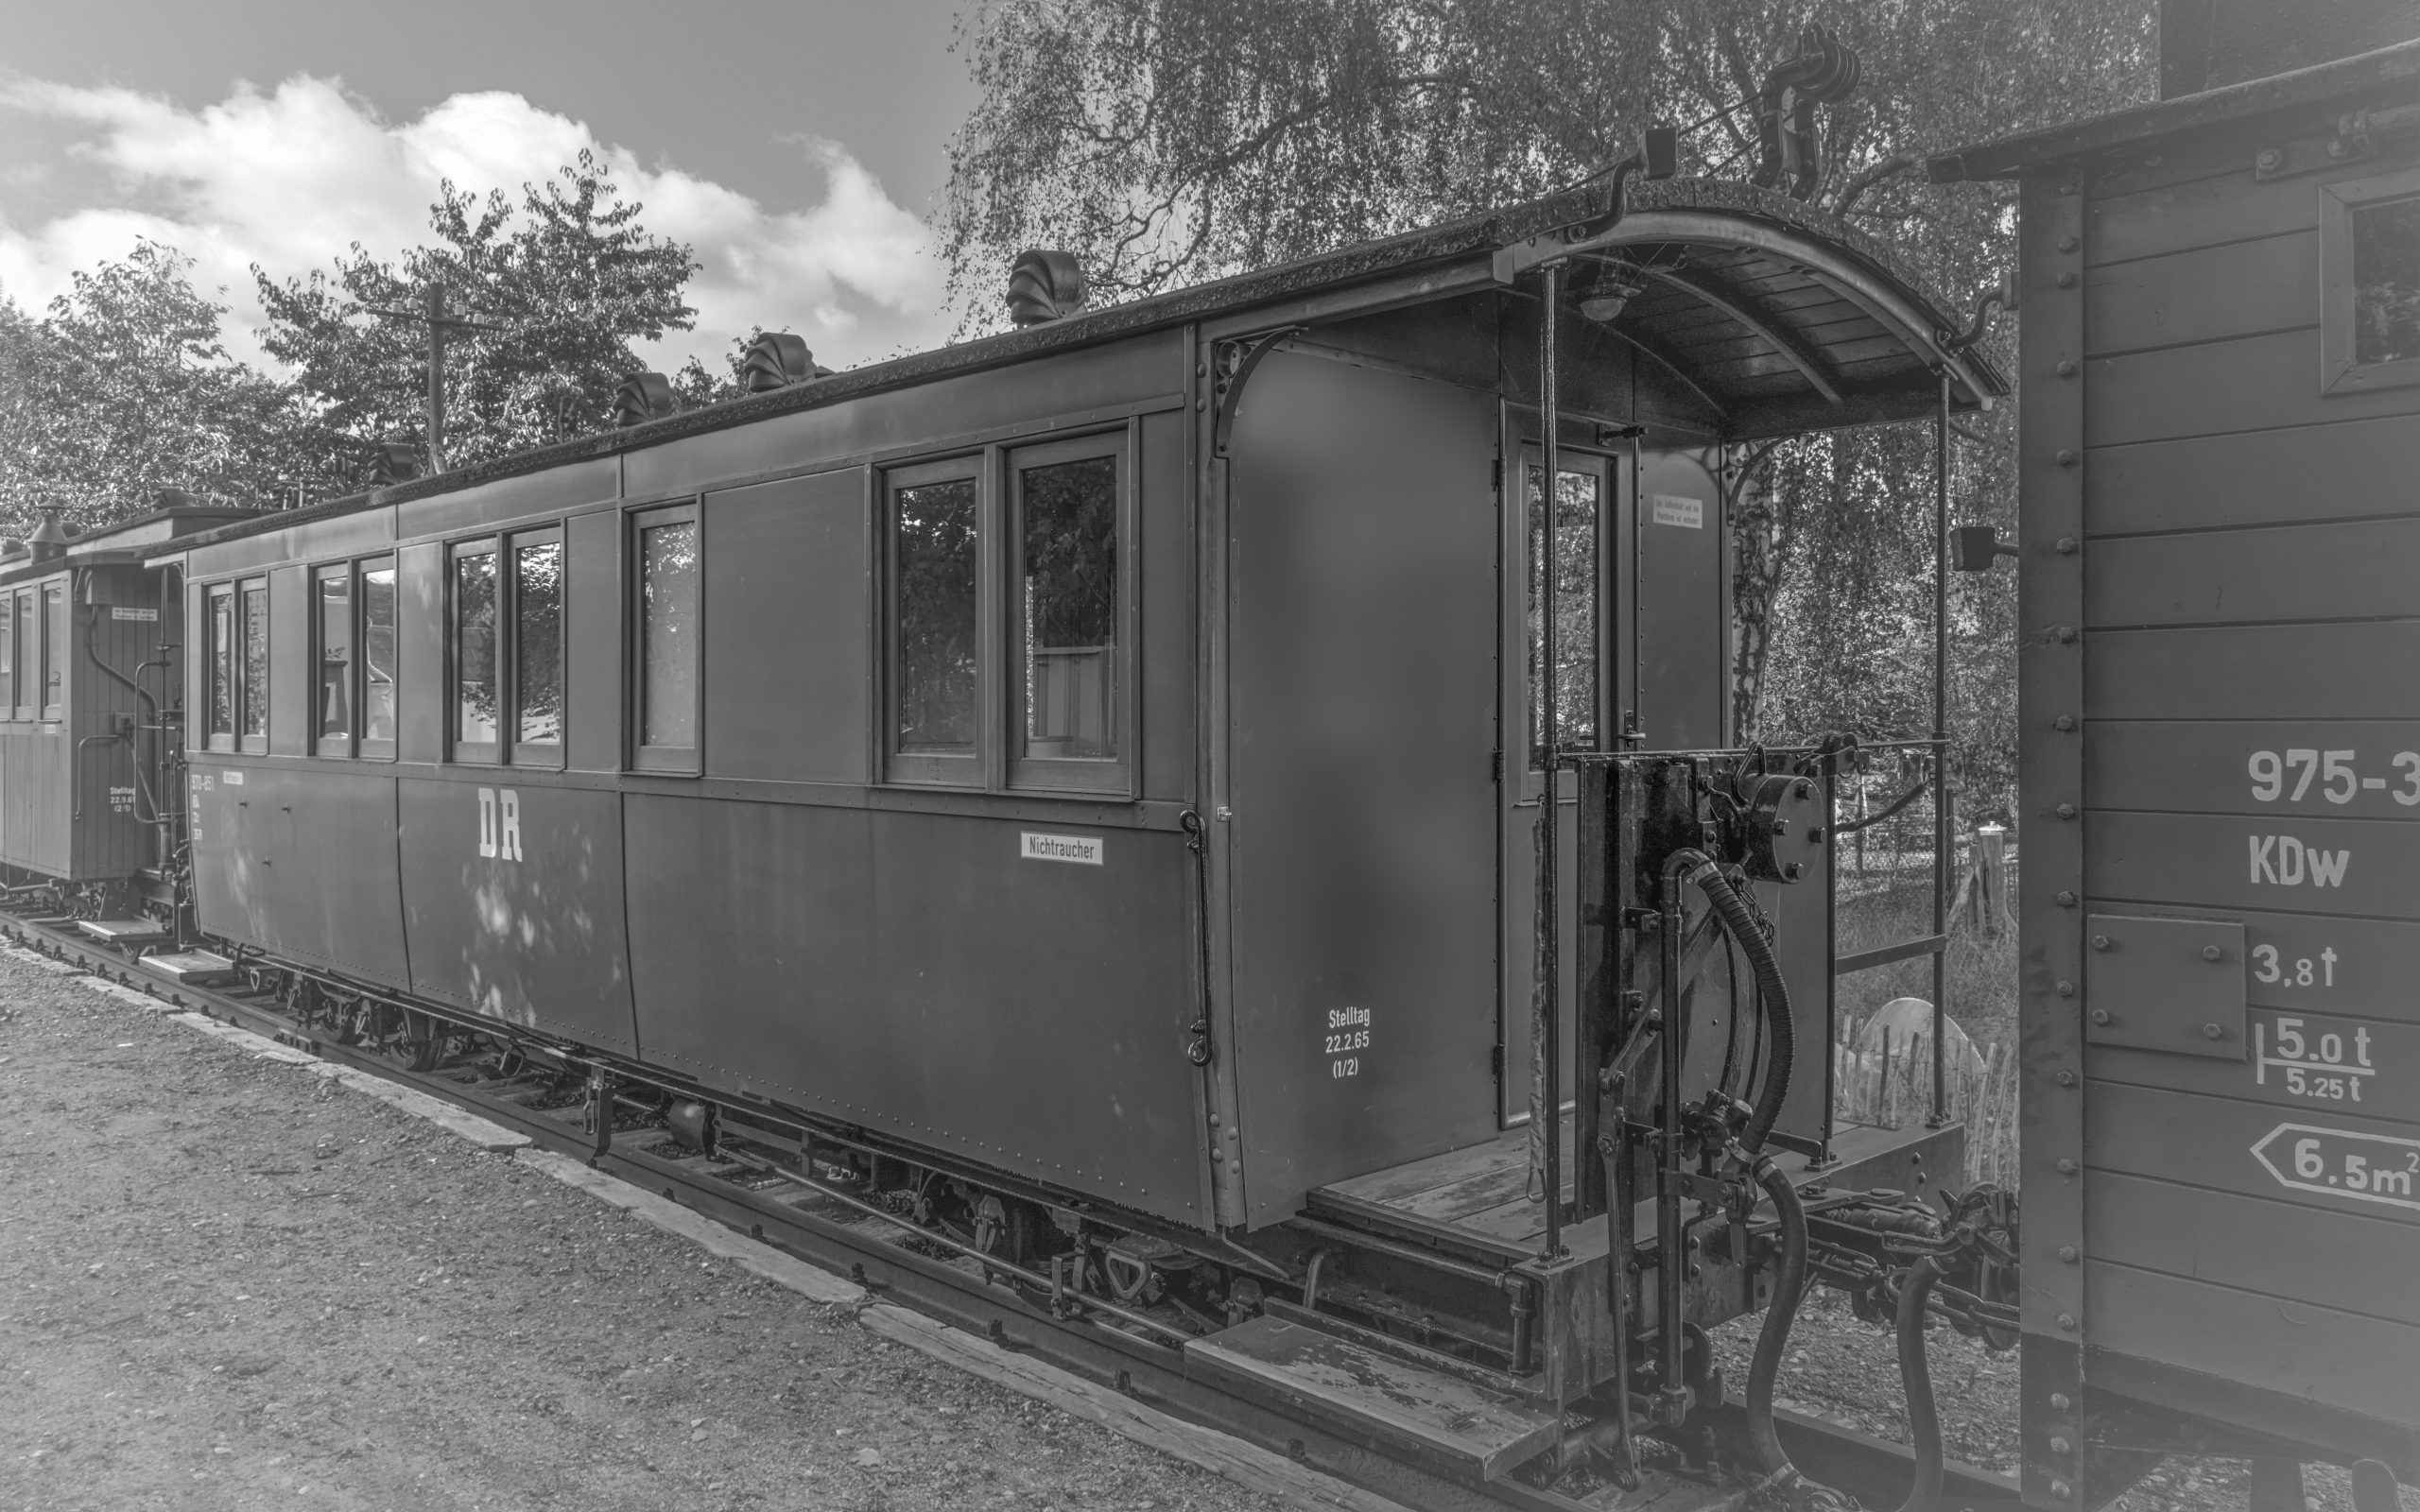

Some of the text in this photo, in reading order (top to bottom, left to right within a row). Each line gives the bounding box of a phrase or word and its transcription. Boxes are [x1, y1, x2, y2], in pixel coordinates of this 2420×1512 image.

[2248, 748, 2420, 806] 975-3
[478, 787, 523, 863] DR
[1029, 835, 1095, 860] Nichtraucher
[2249, 834, 2350, 887] KDw
[1328, 1005, 1370, 1029] Stelltag
[1325, 1030, 1370, 1054] 22.2.65
[1333, 1057, 1358, 1079] (1/2)
